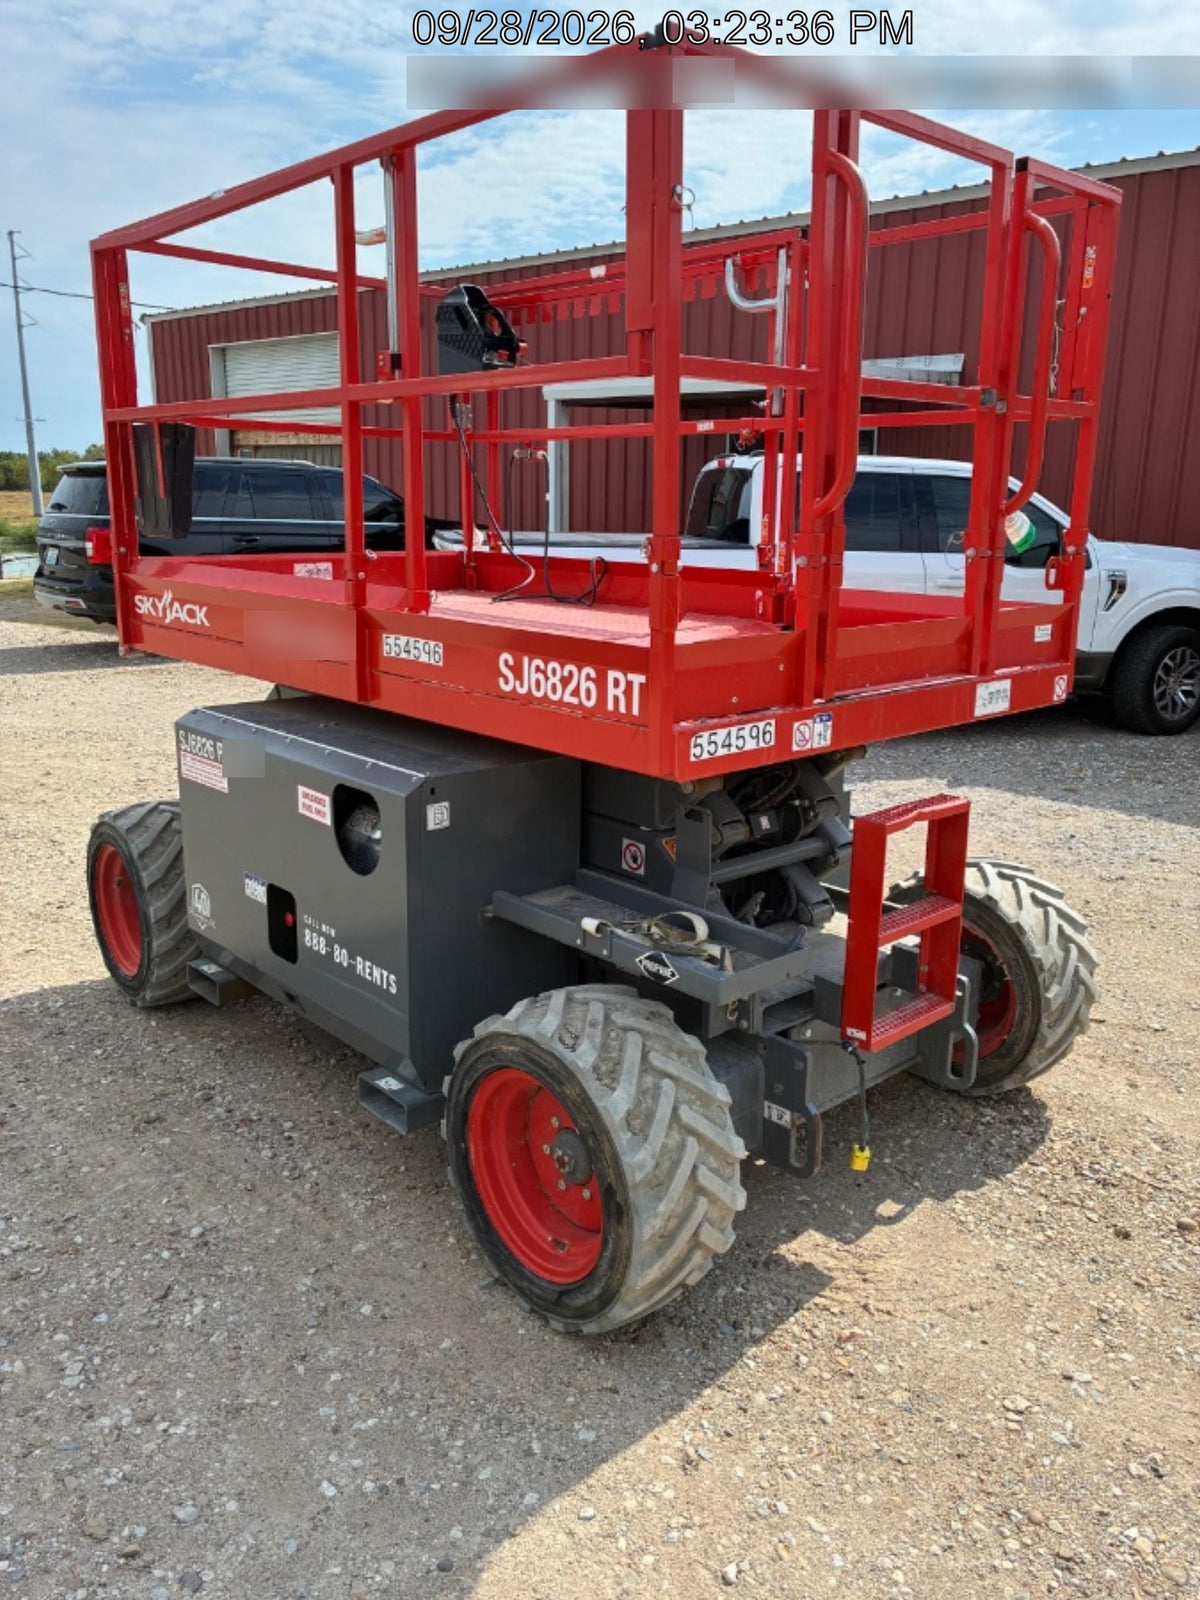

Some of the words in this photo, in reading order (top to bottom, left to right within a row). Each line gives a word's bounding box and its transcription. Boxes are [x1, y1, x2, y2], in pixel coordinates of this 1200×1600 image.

[134, 589, 210, 627] SKYJACK
[384, 635, 443, 665] 554596
[498, 652, 598, 708] SJ6826
[607, 669, 646, 717] RT
[178, 729, 216, 760] SJ6826
[692, 721, 773, 760] 554596
